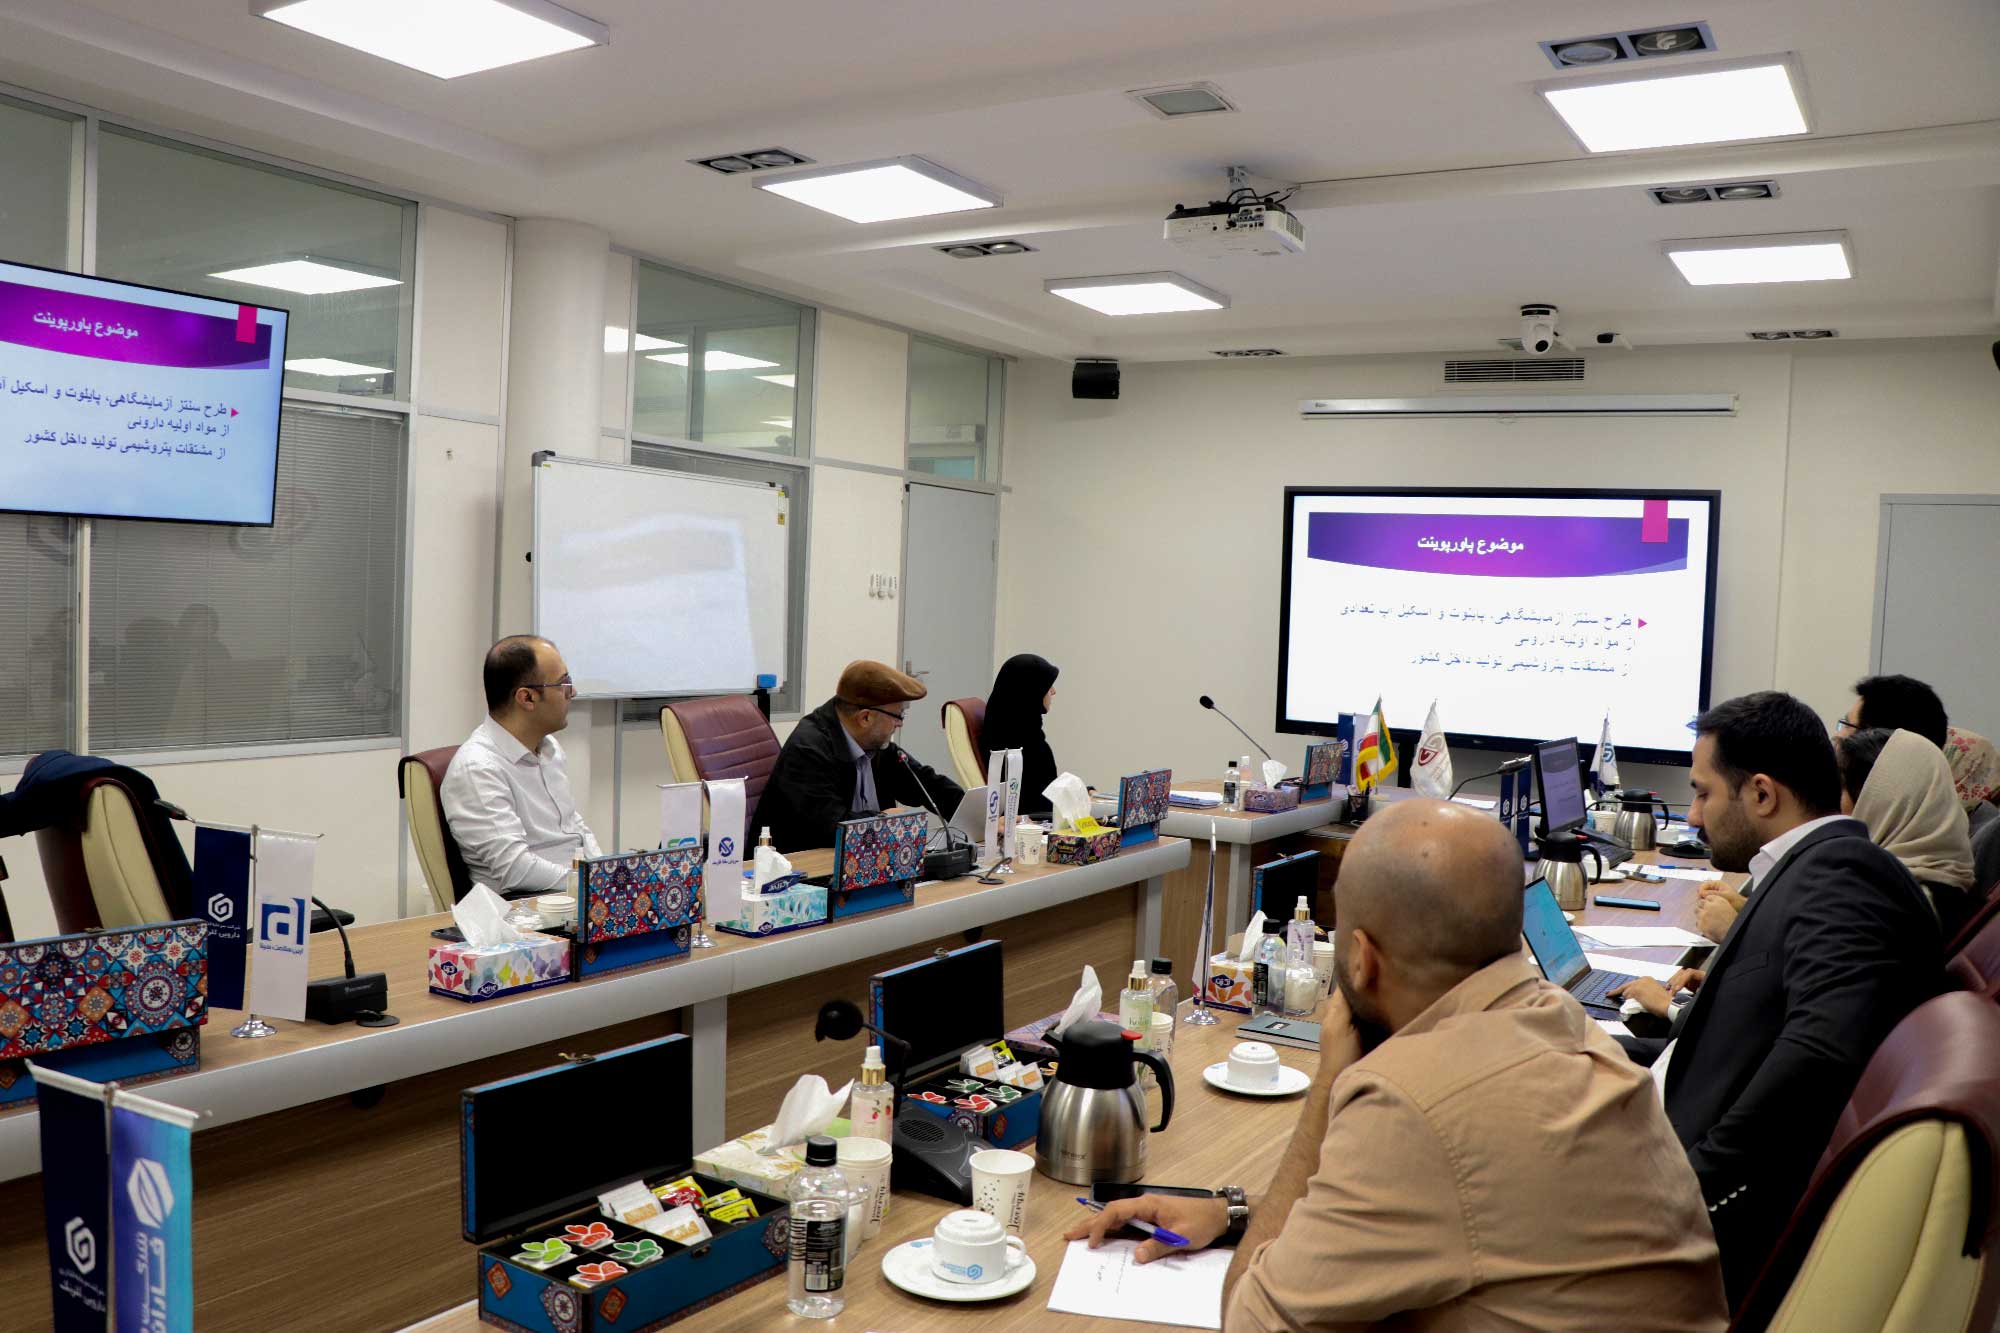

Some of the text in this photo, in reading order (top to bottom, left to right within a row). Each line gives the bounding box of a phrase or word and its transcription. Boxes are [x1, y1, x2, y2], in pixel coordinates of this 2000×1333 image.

[33, 311, 139, 339] موضوع پاورپوینت
[10, 379, 48, 395] اسکیل
[53, 388, 62, 399] و
[65, 387, 101, 405] پایلوت
[178, 399, 201, 413] سنتز
[203, 402, 227, 418] طرح
[167, 418, 192, 433] اولیه
[195, 421, 217, 435] مواد
[220, 424, 230, 437] از
[24, 429, 226, 460] از مشتقات پتروشیمی تولید داخل کشور
[1417, 536, 1525, 555] موضوع پاورپوینت
